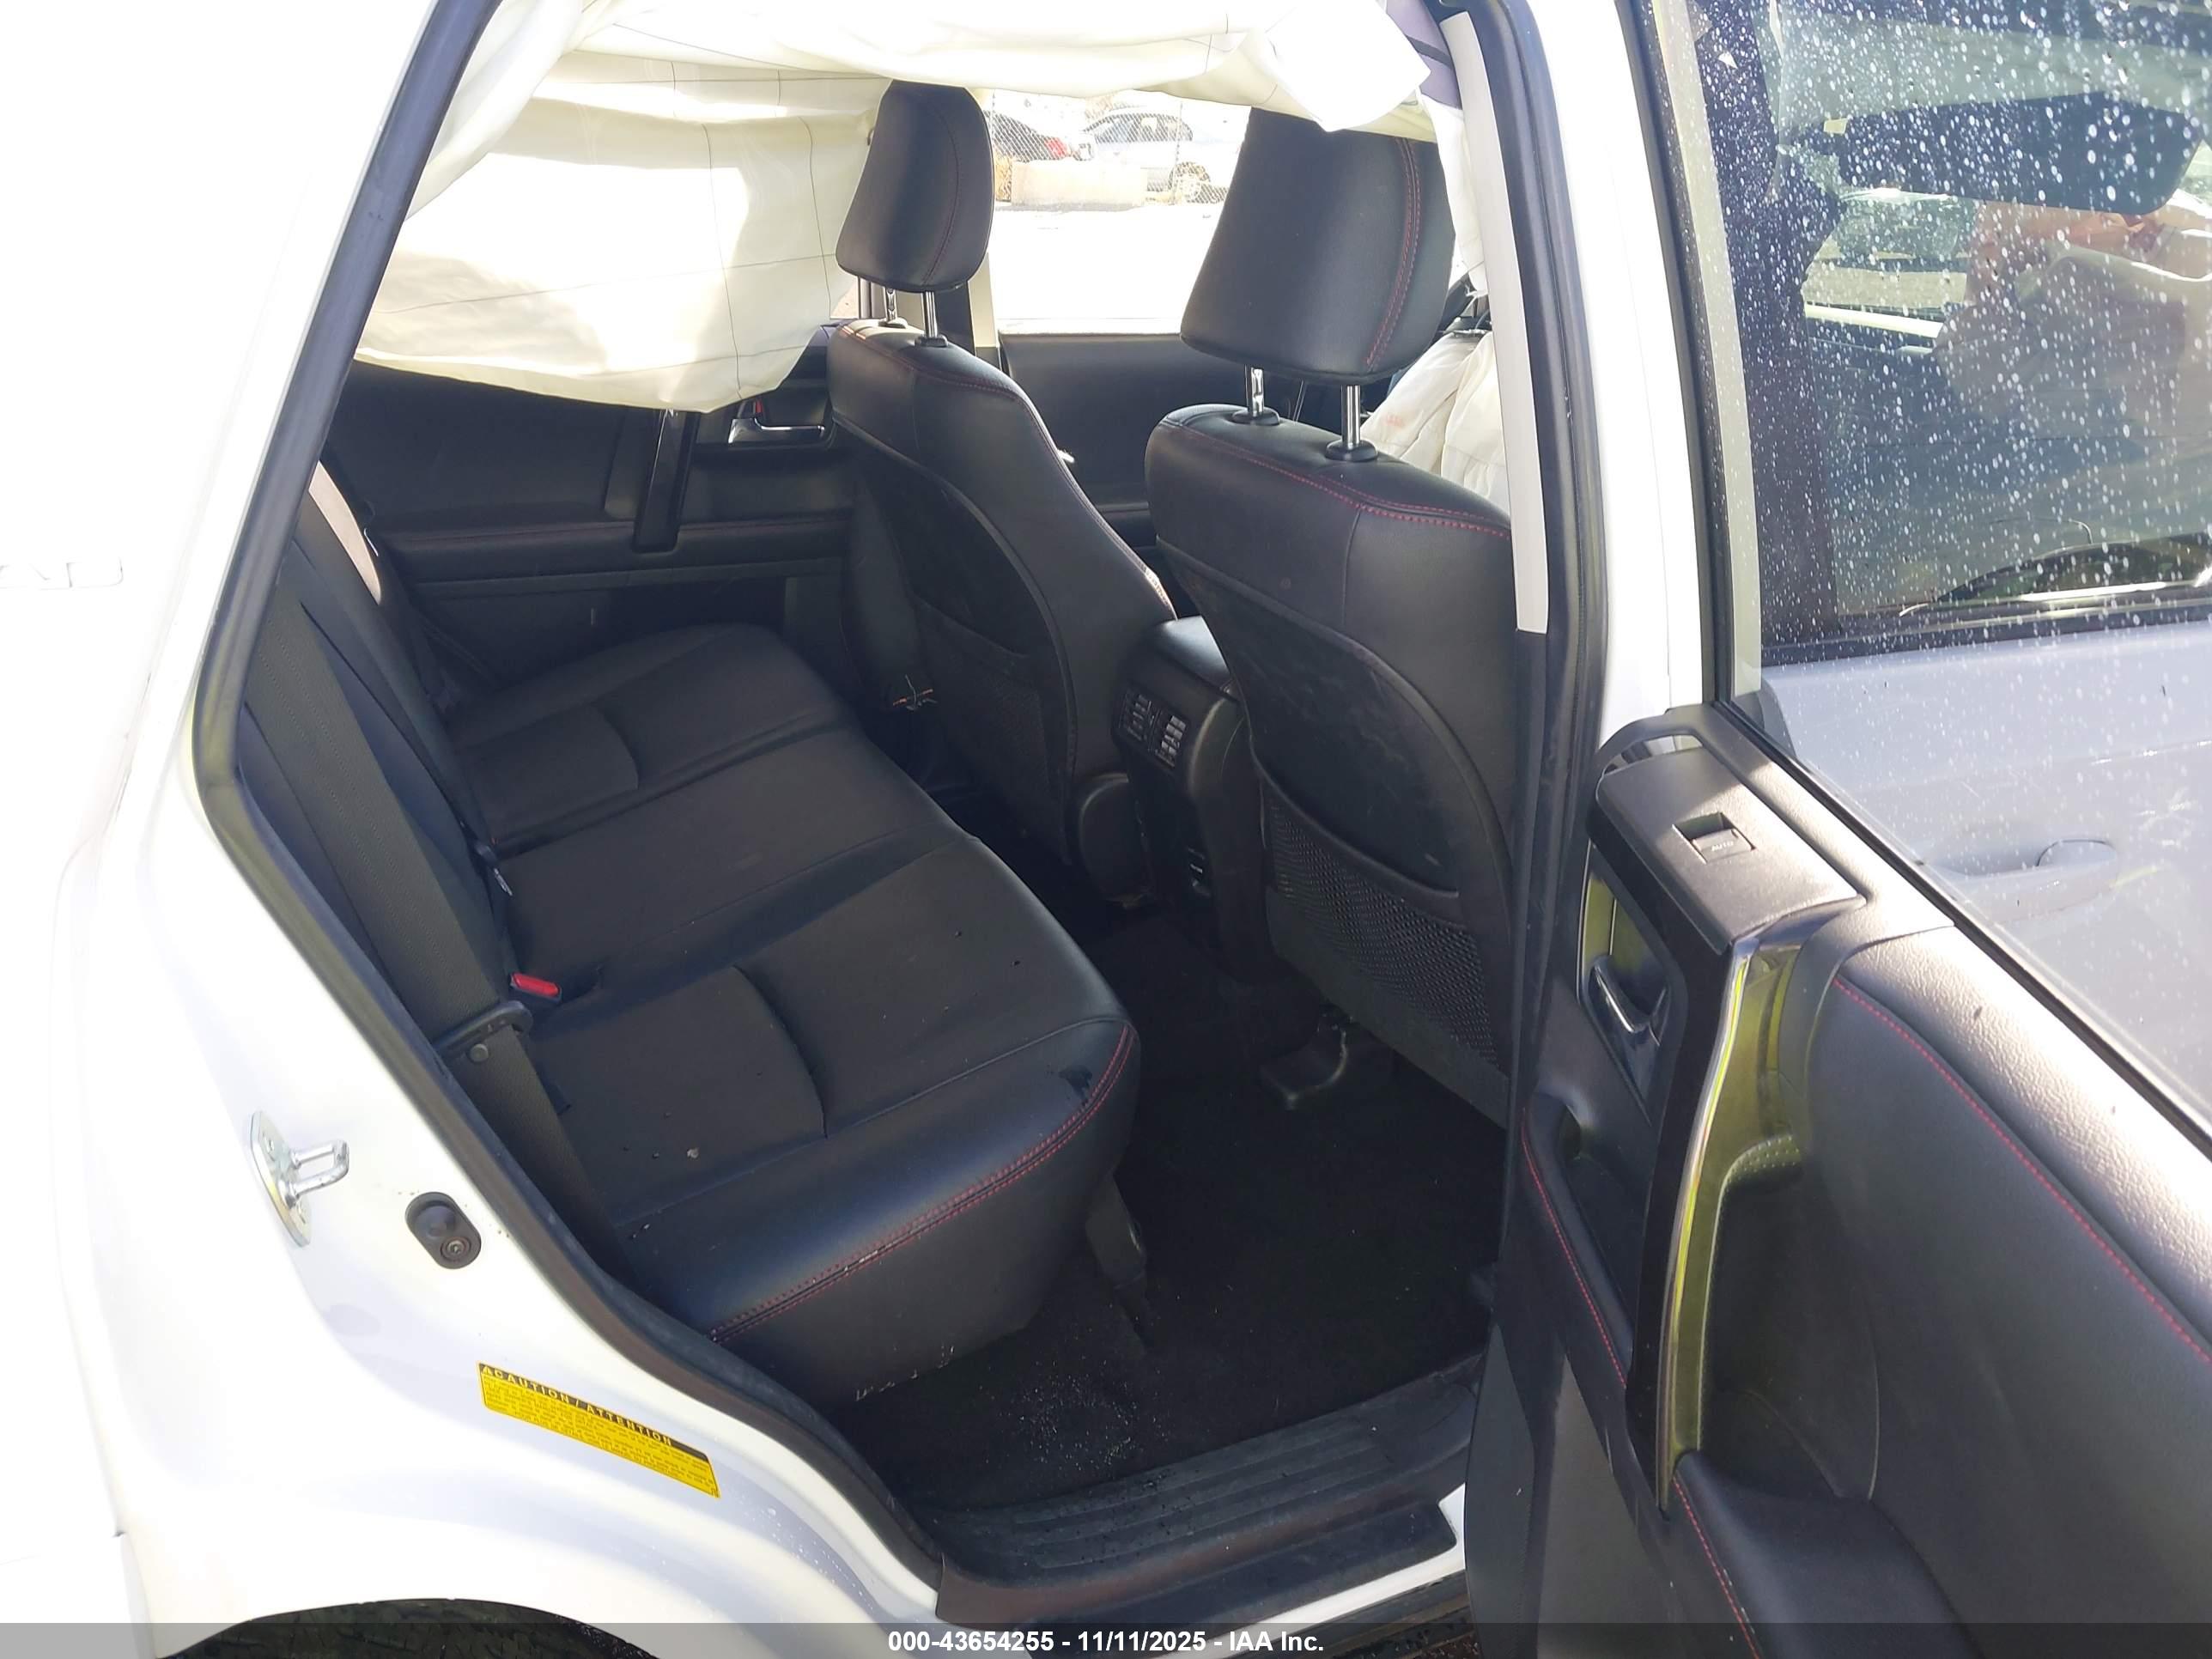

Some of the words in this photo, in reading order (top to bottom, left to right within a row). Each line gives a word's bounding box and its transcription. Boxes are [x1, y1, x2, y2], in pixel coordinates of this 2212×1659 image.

[1711, 840, 1735, 852] AUTO
[494, 1368, 569, 1405] CAUTION
[586, 1404, 672, 1447] ATTENTION
